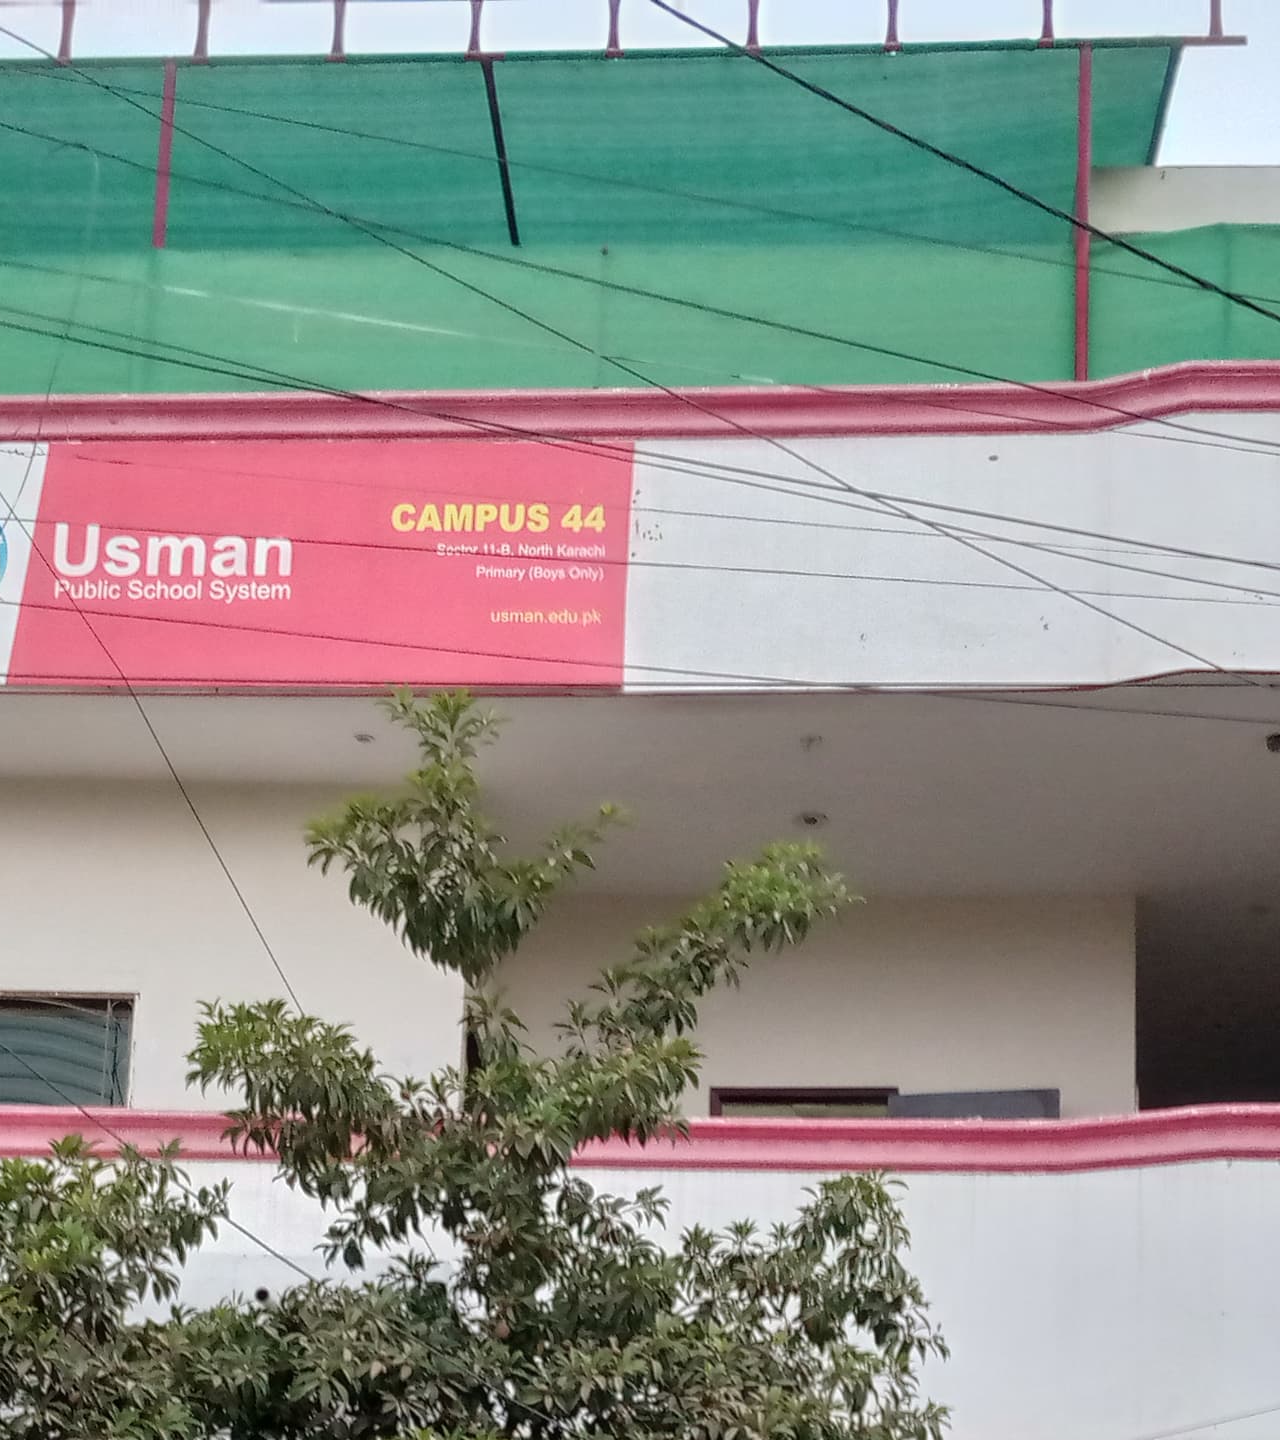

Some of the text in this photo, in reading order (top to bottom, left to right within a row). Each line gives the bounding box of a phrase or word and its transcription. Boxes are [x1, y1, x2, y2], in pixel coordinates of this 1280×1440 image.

[391, 503, 606, 533] CAMPUS 44
[53, 522, 293, 577] Usman
[436, 543, 479, 556] Sector
[519, 543, 553, 557] North
[557, 544, 606, 558] Karachi
[476, 565, 604, 582] Primary (Boys Only)
[54, 579, 291, 604] Public School System
[490, 609, 602, 626] usman.edu.pk
